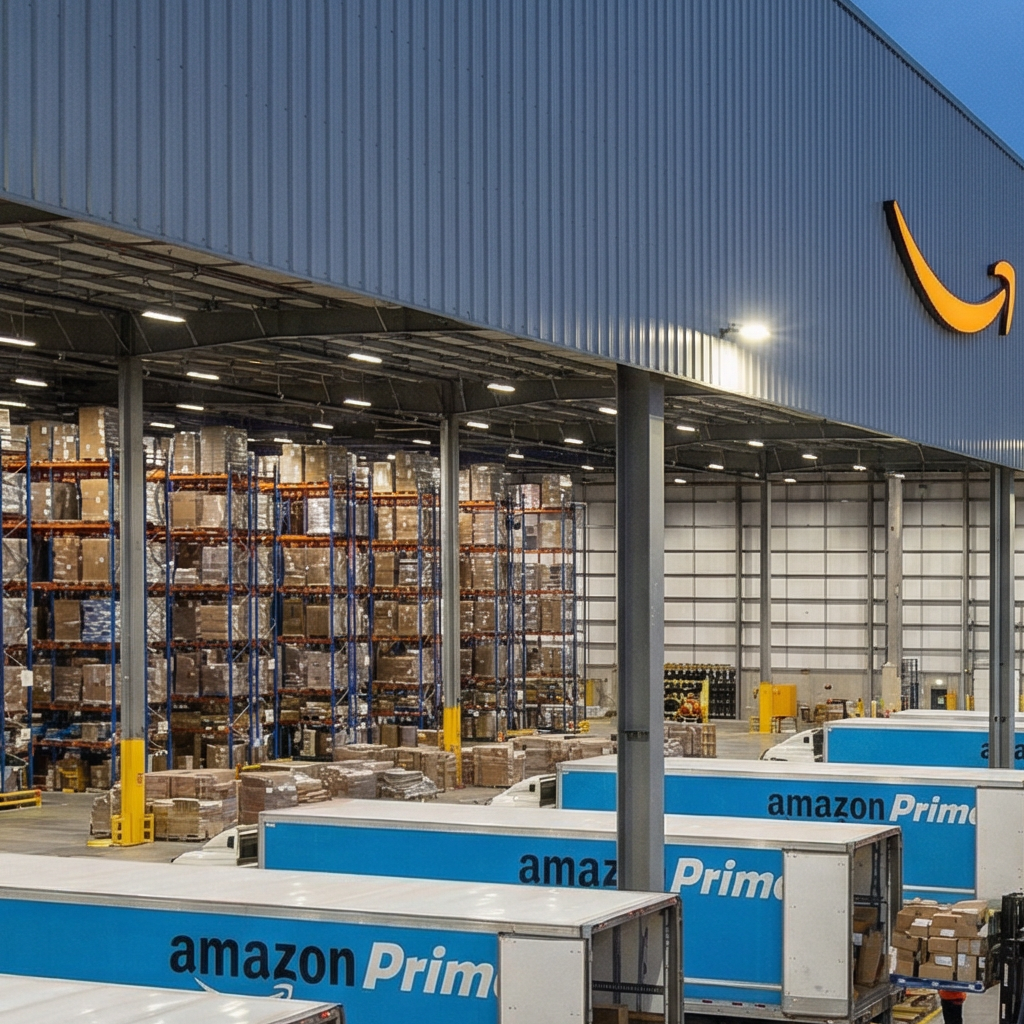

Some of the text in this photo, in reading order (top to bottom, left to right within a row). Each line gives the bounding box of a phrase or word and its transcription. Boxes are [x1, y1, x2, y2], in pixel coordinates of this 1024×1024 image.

[767, 793, 885, 820] amazon
[519, 854, 617, 887] amaz
[170, 935, 498, 998] amazon Prim
